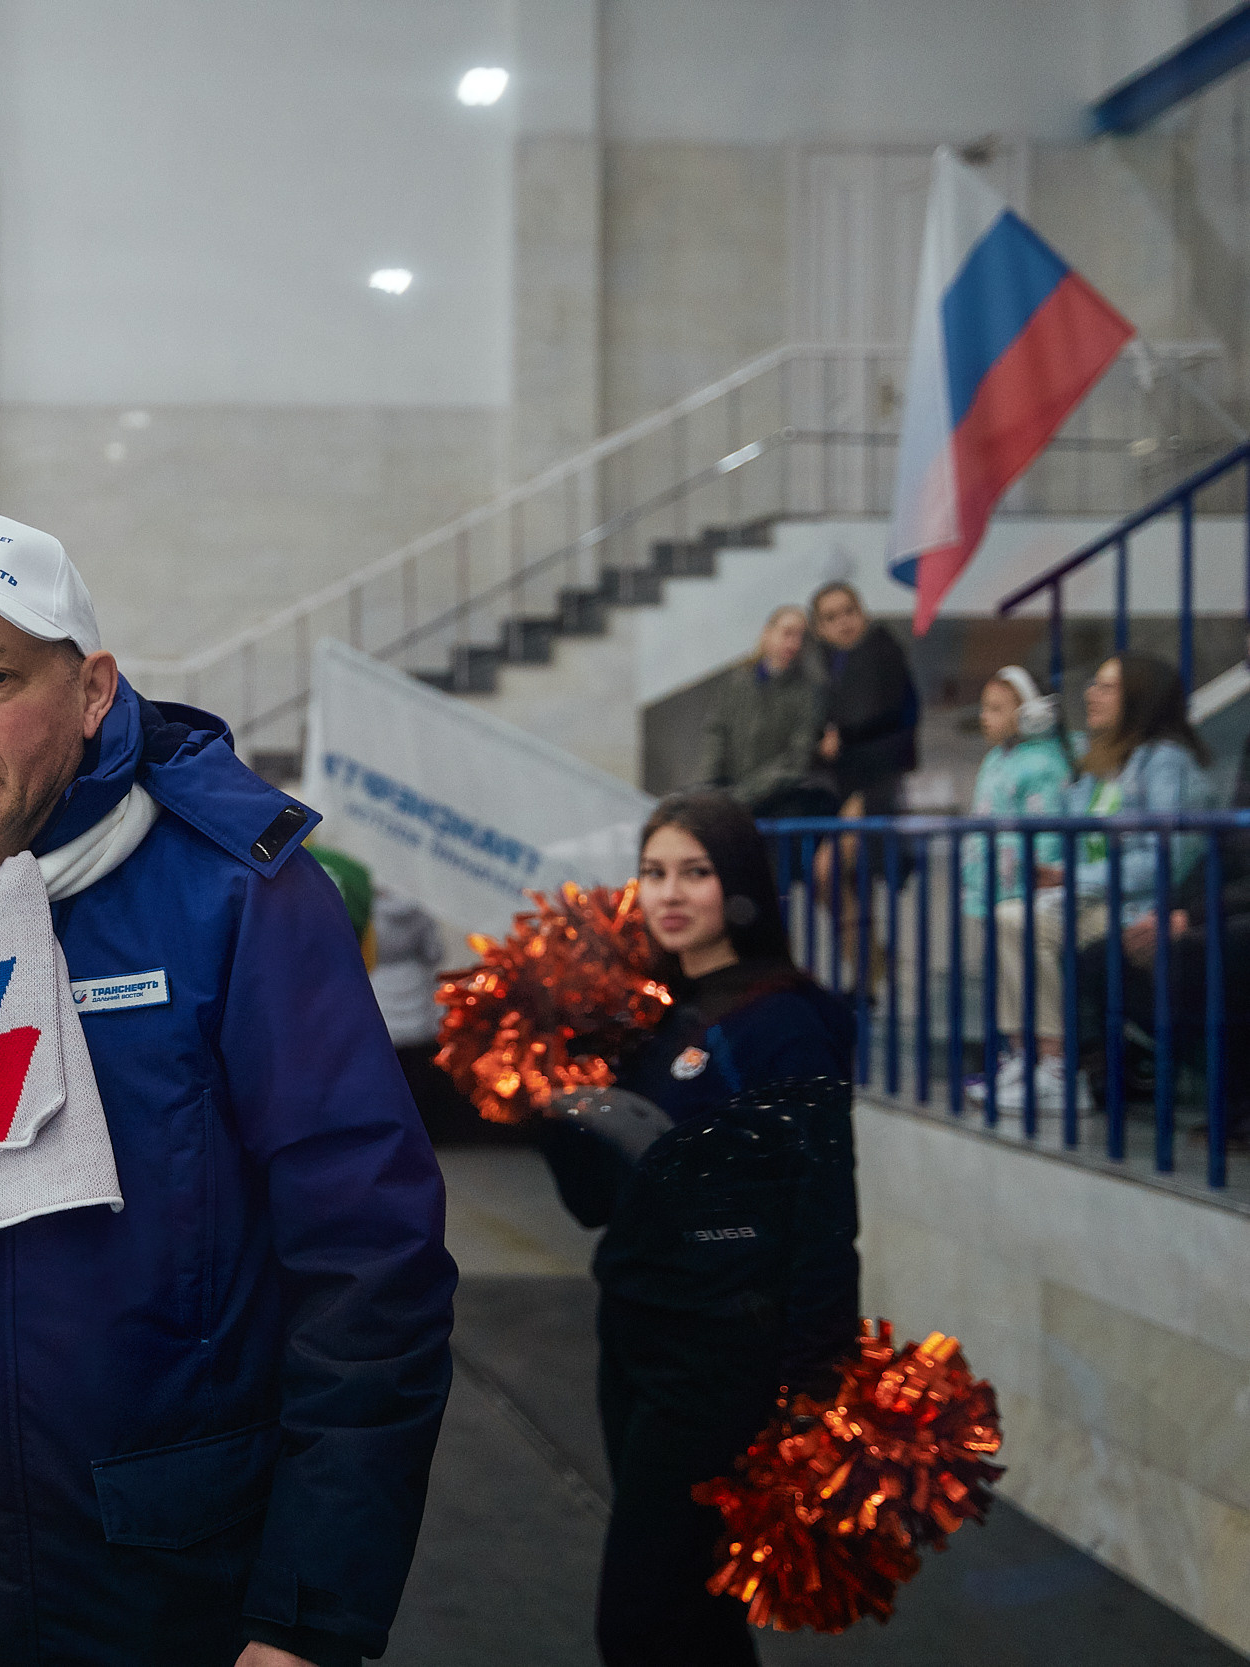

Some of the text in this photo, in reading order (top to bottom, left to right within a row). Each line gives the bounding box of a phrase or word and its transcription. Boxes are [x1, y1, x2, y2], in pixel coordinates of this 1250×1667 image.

[91, 981, 158, 996] ТРАНСНЕФТЬ
[92, 992, 144, 1003] ДАЛЬНИЙ ВОСТОК
